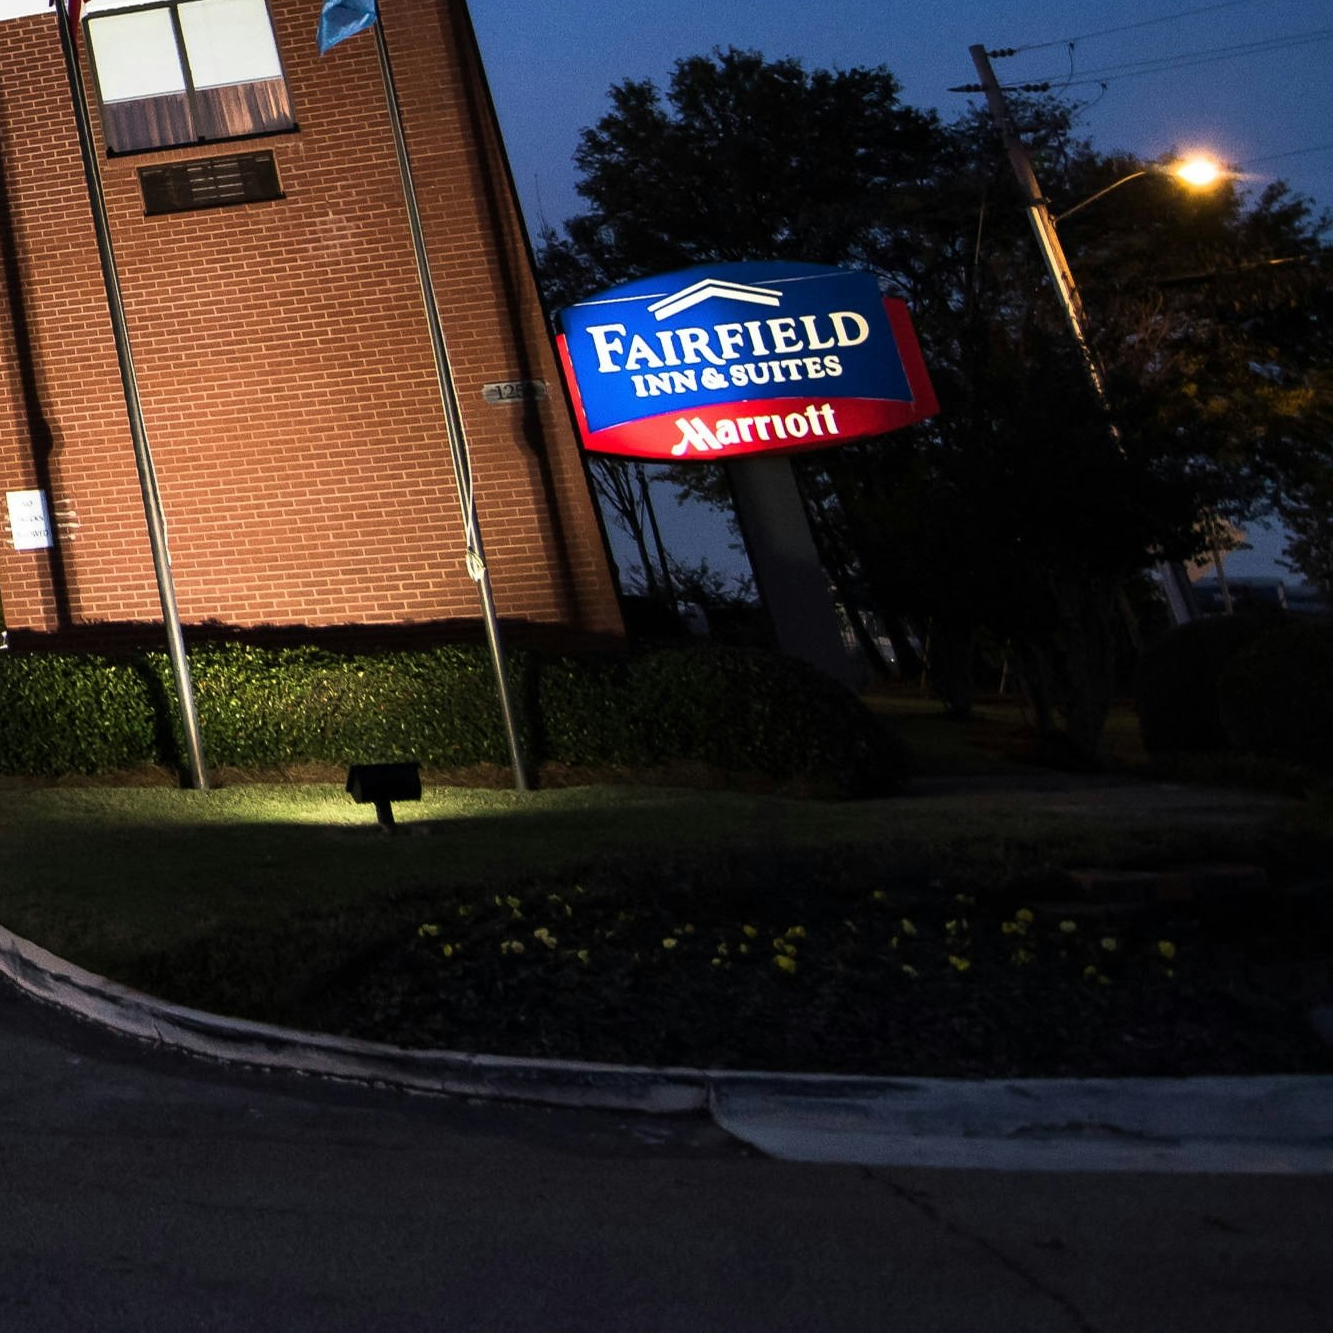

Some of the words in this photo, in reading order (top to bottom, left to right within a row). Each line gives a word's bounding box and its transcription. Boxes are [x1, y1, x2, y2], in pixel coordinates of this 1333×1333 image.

[585, 311, 870, 374] FAIRFIELD
[631, 369, 699, 398] INN
[701, 367, 729, 391] &
[730, 355, 843, 387] SUITES
[671, 402, 840, 456] Marriott
